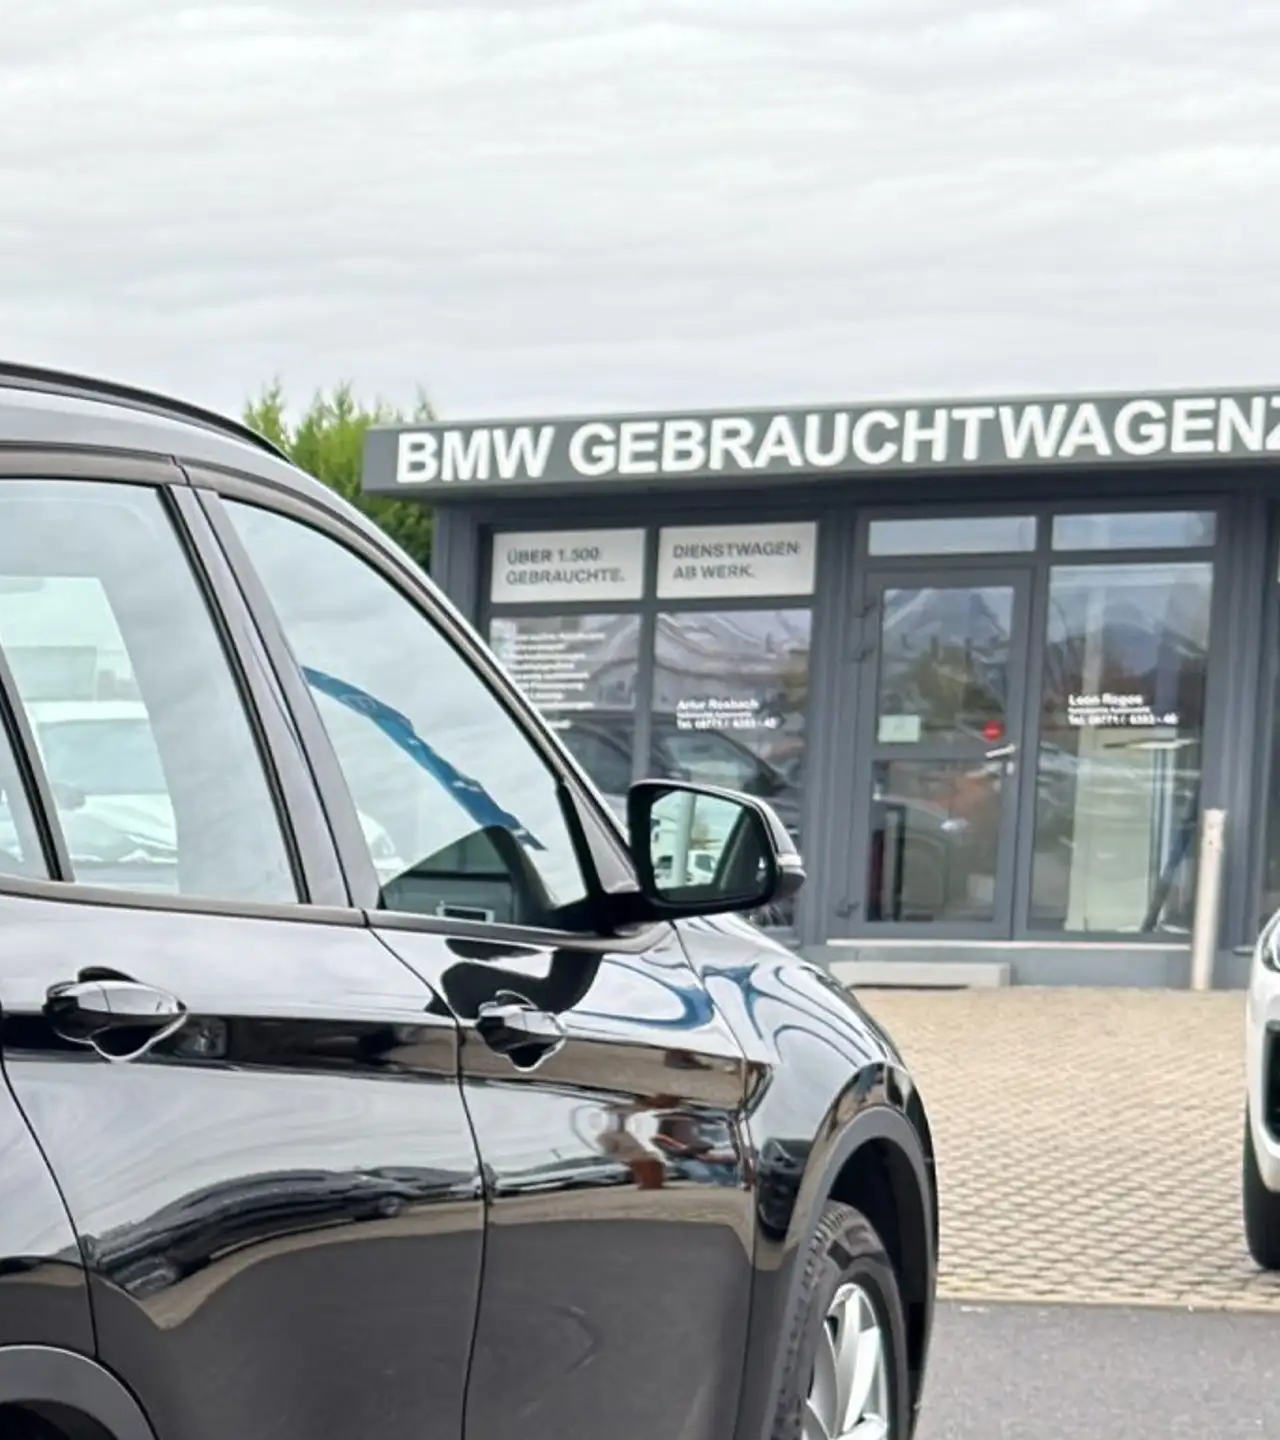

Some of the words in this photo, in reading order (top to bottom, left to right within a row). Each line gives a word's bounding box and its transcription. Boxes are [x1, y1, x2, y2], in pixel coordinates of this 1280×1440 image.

[396, 427, 554, 483] BMW
[507, 549, 553, 565] ÜBER
[672, 540, 799, 558] DIENSTWAGEN
[506, 566, 626, 586] GEBRAUCHTE.
[672, 565, 697, 581] AB
[702, 563, 755, 580] WERK.
